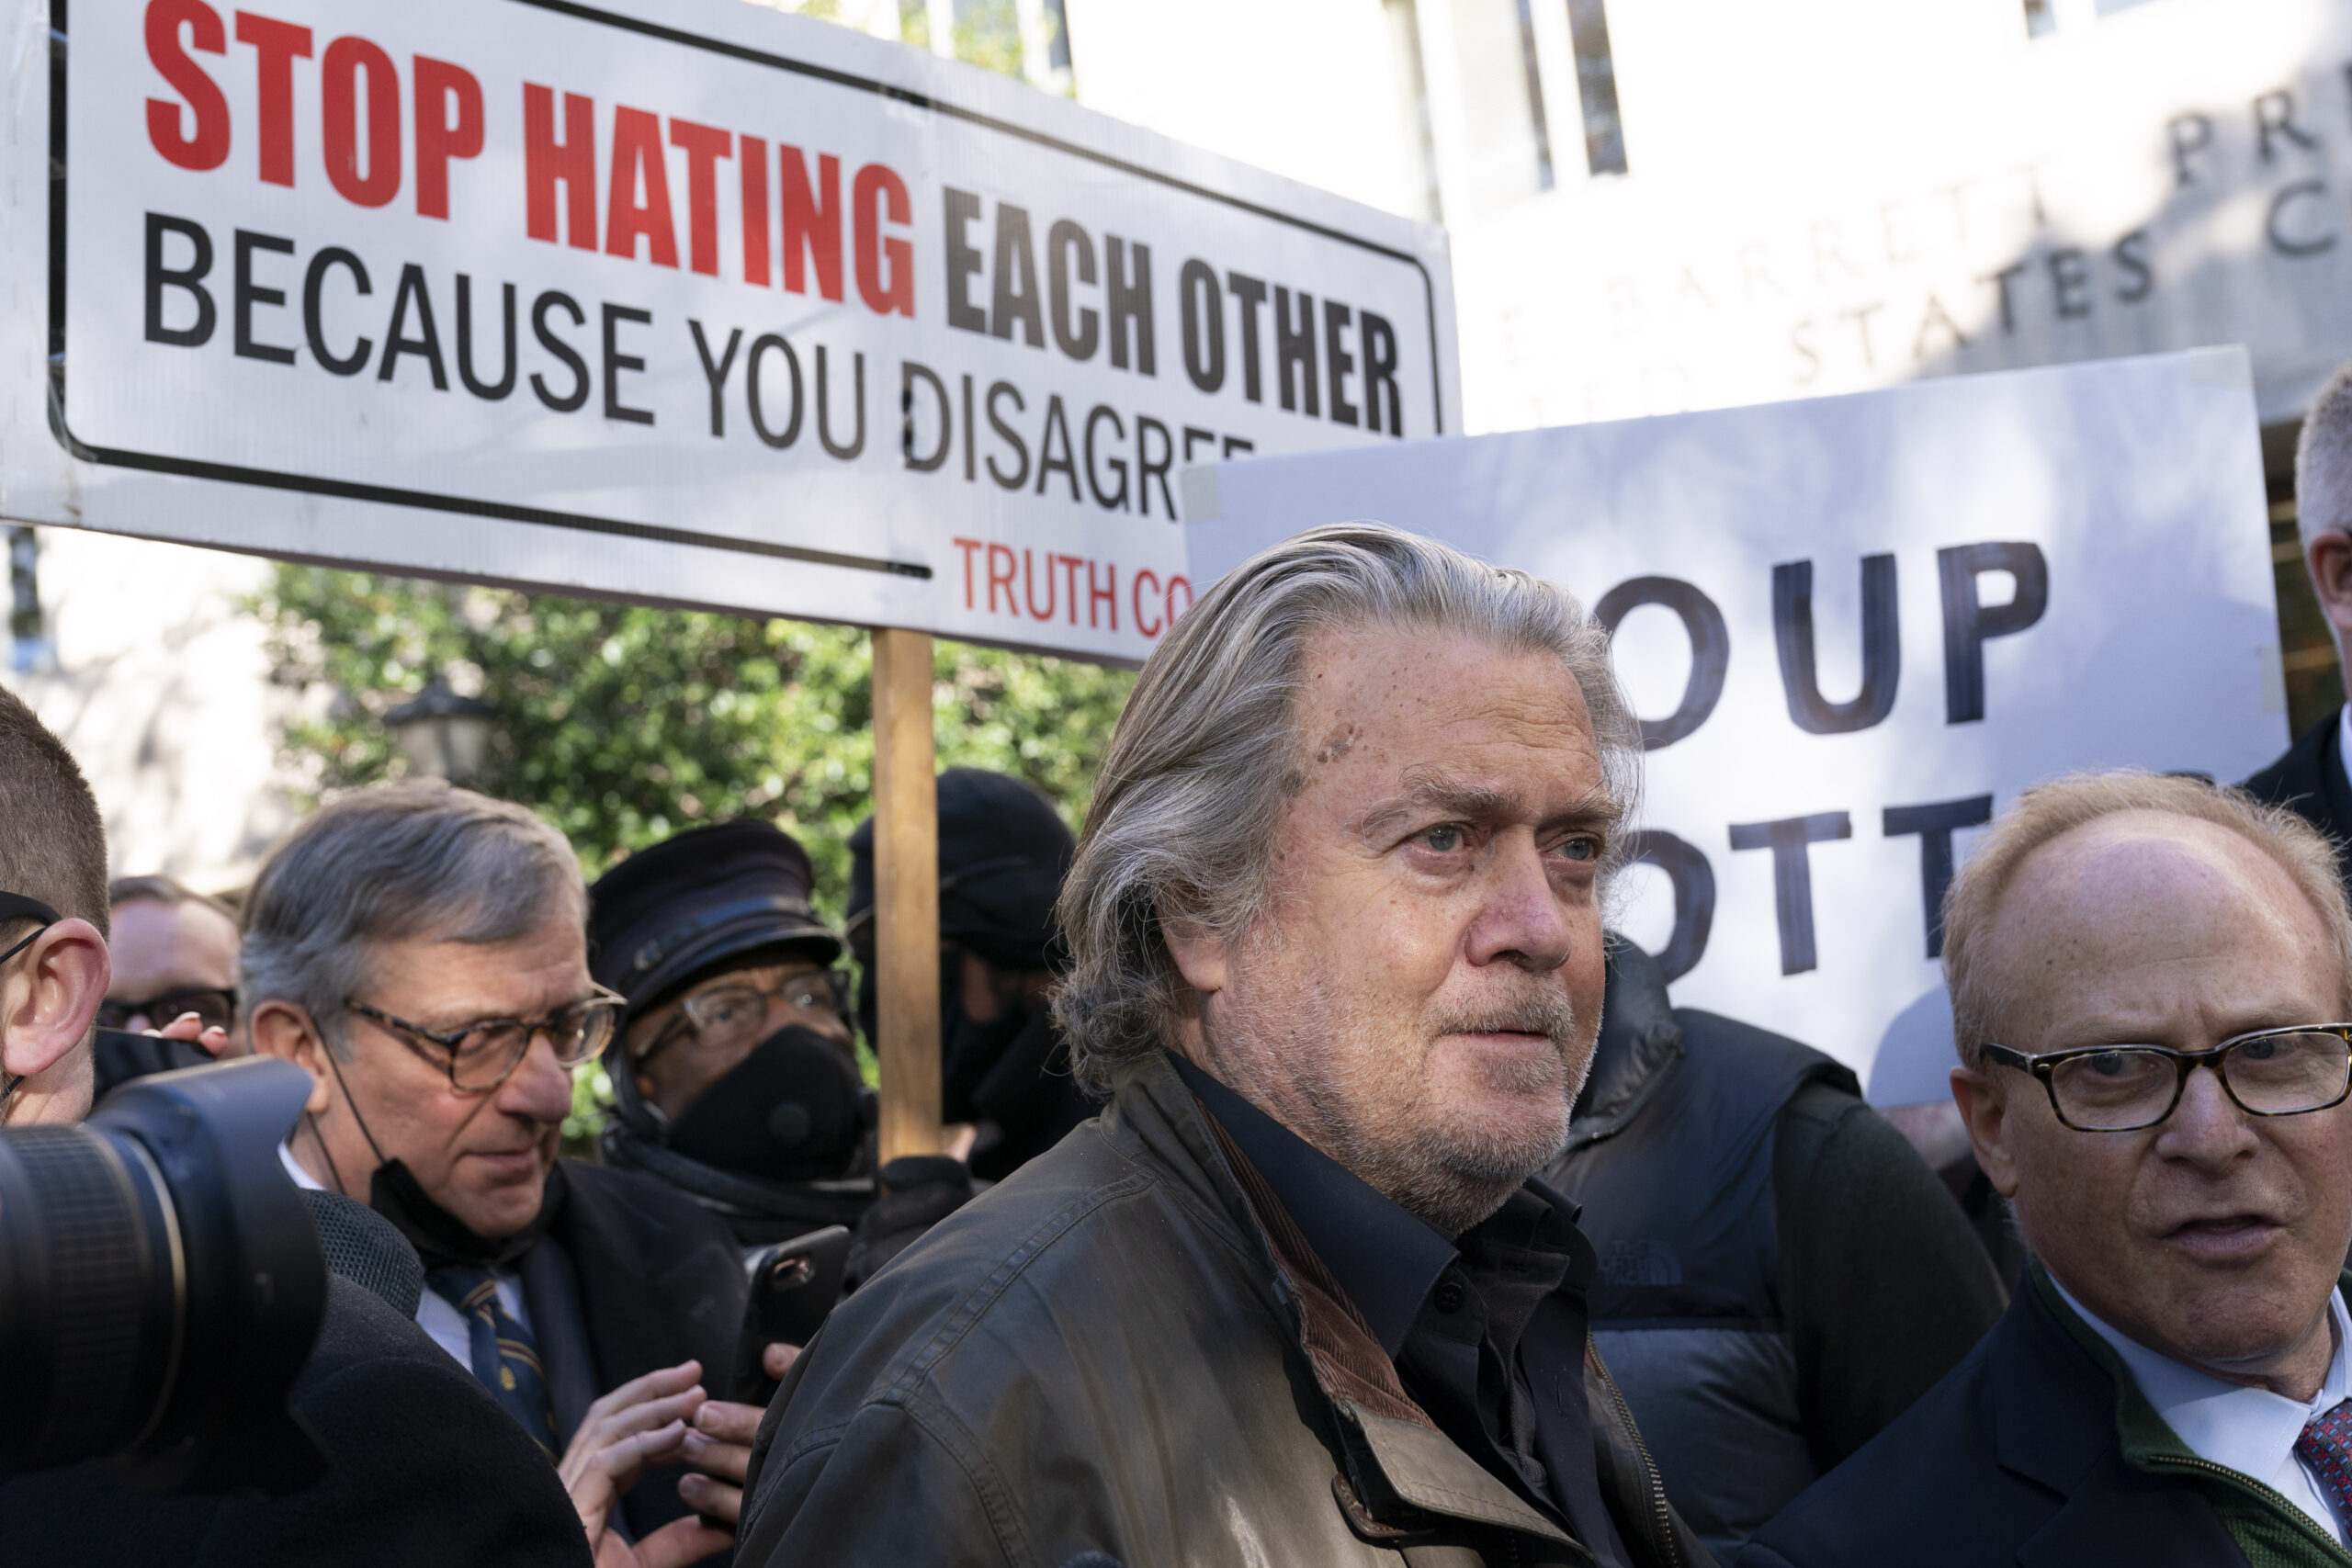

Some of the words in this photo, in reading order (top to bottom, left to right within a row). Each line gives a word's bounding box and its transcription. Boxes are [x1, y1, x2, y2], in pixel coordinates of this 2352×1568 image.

[144, 0, 485, 220] STOP
[523, 81, 915, 318] HATING
[943, 186, 1158, 378] EACH
[1180, 256, 1403, 439] OTHER
[2165, 60, 2352, 186] PR
[144, 211, 655, 426] BECAUSE
[688, 319, 865, 461] YOU
[901, 360, 1255, 522] DISAGR
[1786, 230, 2153, 389] STATES
[2266, 179, 2352, 259] C
[953, 536, 1118, 633] TRUTH
[1592, 541, 2049, 751] OUP
